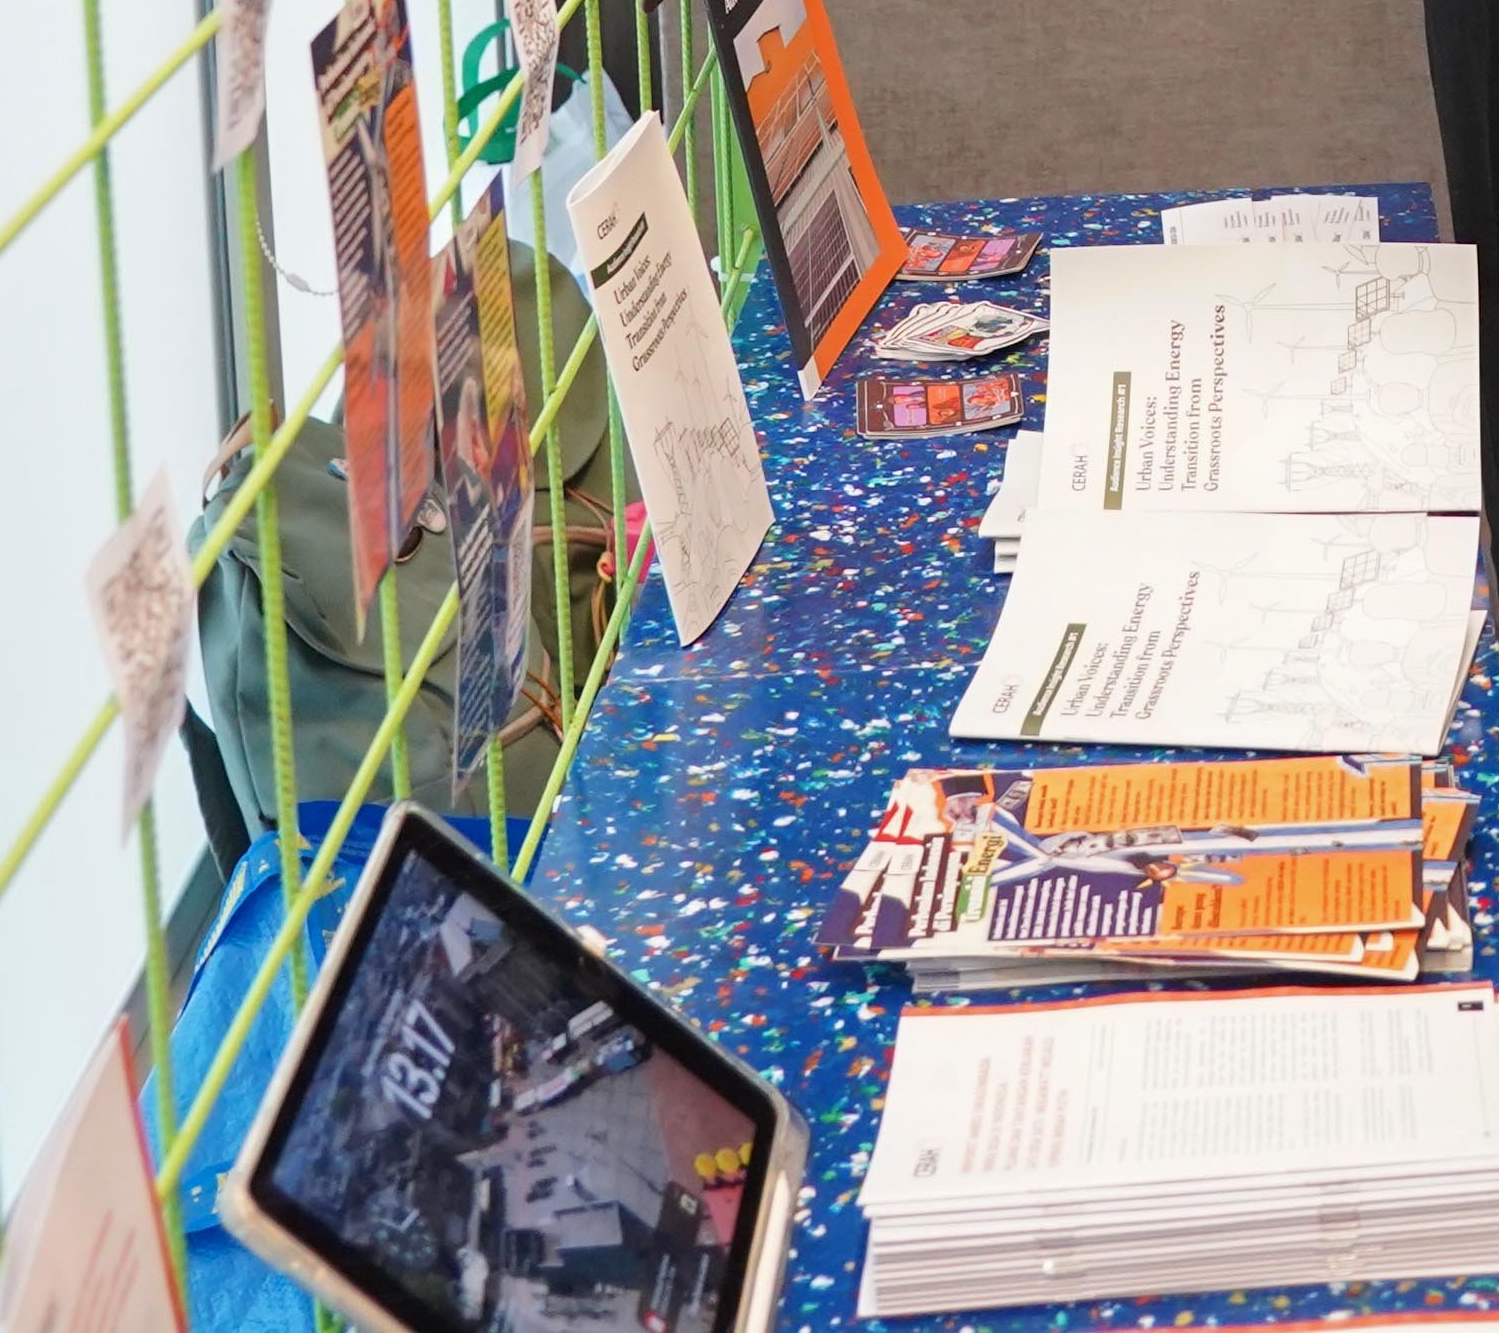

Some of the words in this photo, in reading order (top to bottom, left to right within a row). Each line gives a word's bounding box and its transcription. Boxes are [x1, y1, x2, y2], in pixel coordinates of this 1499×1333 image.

[597, 212, 618, 240] CERAH
[613, 279, 637, 305] Urban
[619, 275, 660, 328] Understanding
[625, 309, 653, 350] Transition
[632, 334, 663, 372] Grassroots
[659, 288, 688, 339] Perspectives
[1165, 319, 1186, 382] Energy
[1208, 305, 1228, 414] Perspectives
[1115, 396, 1126, 433] Research
[1138, 396, 1157, 449] Voices:
[1185, 377, 1202, 419] from
[1113, 433, 1126, 460] Insight
[1158, 386, 1181, 492] Understanding
[1181, 418, 1200, 492] Transition
[1204, 416, 1222, 492] Grassroots
[1072, 454, 1089, 491] CERAH
[1110, 459, 1121, 493] Audience
[1135, 450, 1154, 492] Urban
[1085, 636, 1138, 717] Understanding
[1122, 583, 1154, 633] Energy
[1135, 658, 1175, 720] Grassroots
[1161, 571, 1200, 658] Perspectives
[992, 683, 1021, 714] CERAH
[1061, 683, 1092, 716] Urban
[1079, 643, 1108, 684] Voices:
[1110, 661, 1142, 718] Transition
[1140, 630, 1162, 662] from
[967, 835, 1004, 875] Energi
[379, 998, 457, 1121] 13.17
